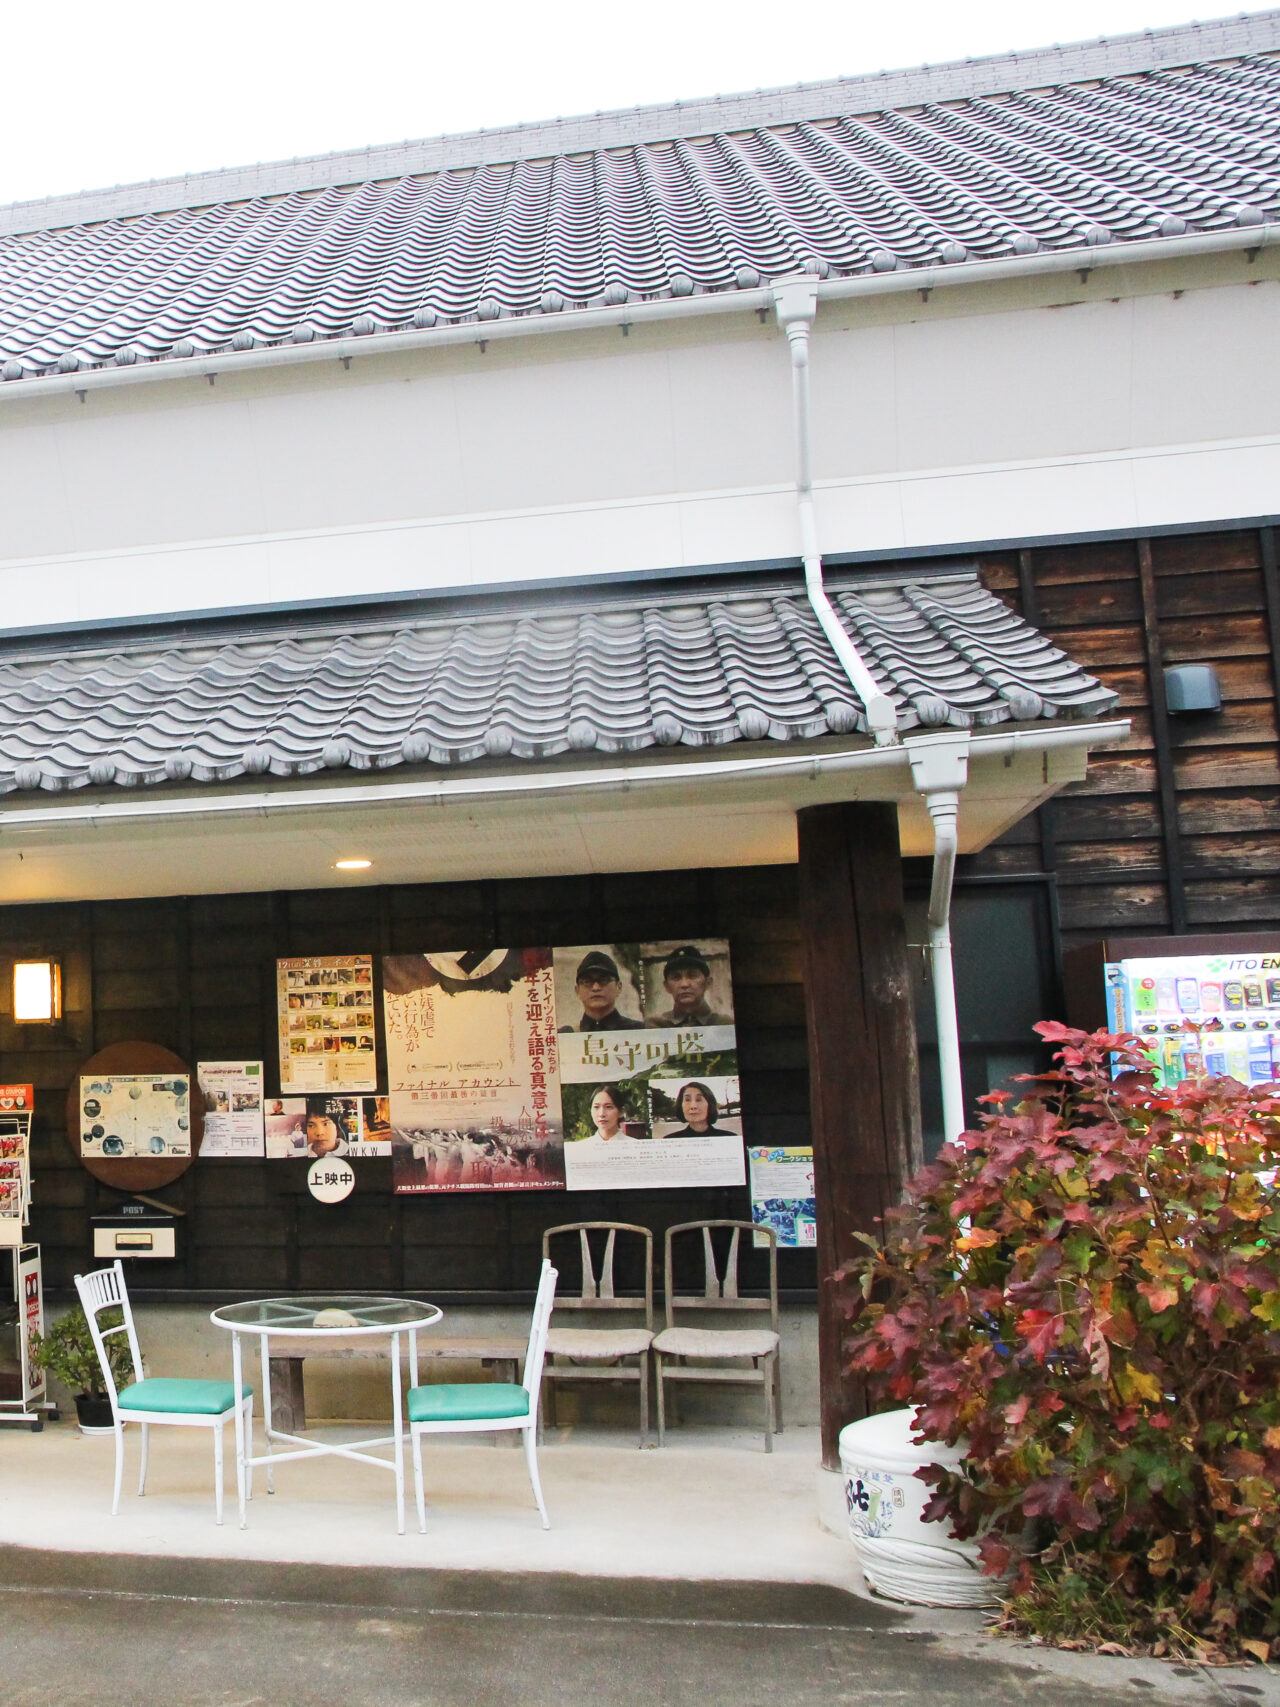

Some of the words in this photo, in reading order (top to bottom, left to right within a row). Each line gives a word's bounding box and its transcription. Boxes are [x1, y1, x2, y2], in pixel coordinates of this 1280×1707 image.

[1229, 959, 1258, 970] ITO
[581, 1031, 705, 1071] 島守の塔
[396, 1081, 450, 1091] ファイナル
[458, 1077, 516, 1089] アカウント
[310, 1172, 352, 1185] 上映中
[123, 1206, 144, 1215] POST
